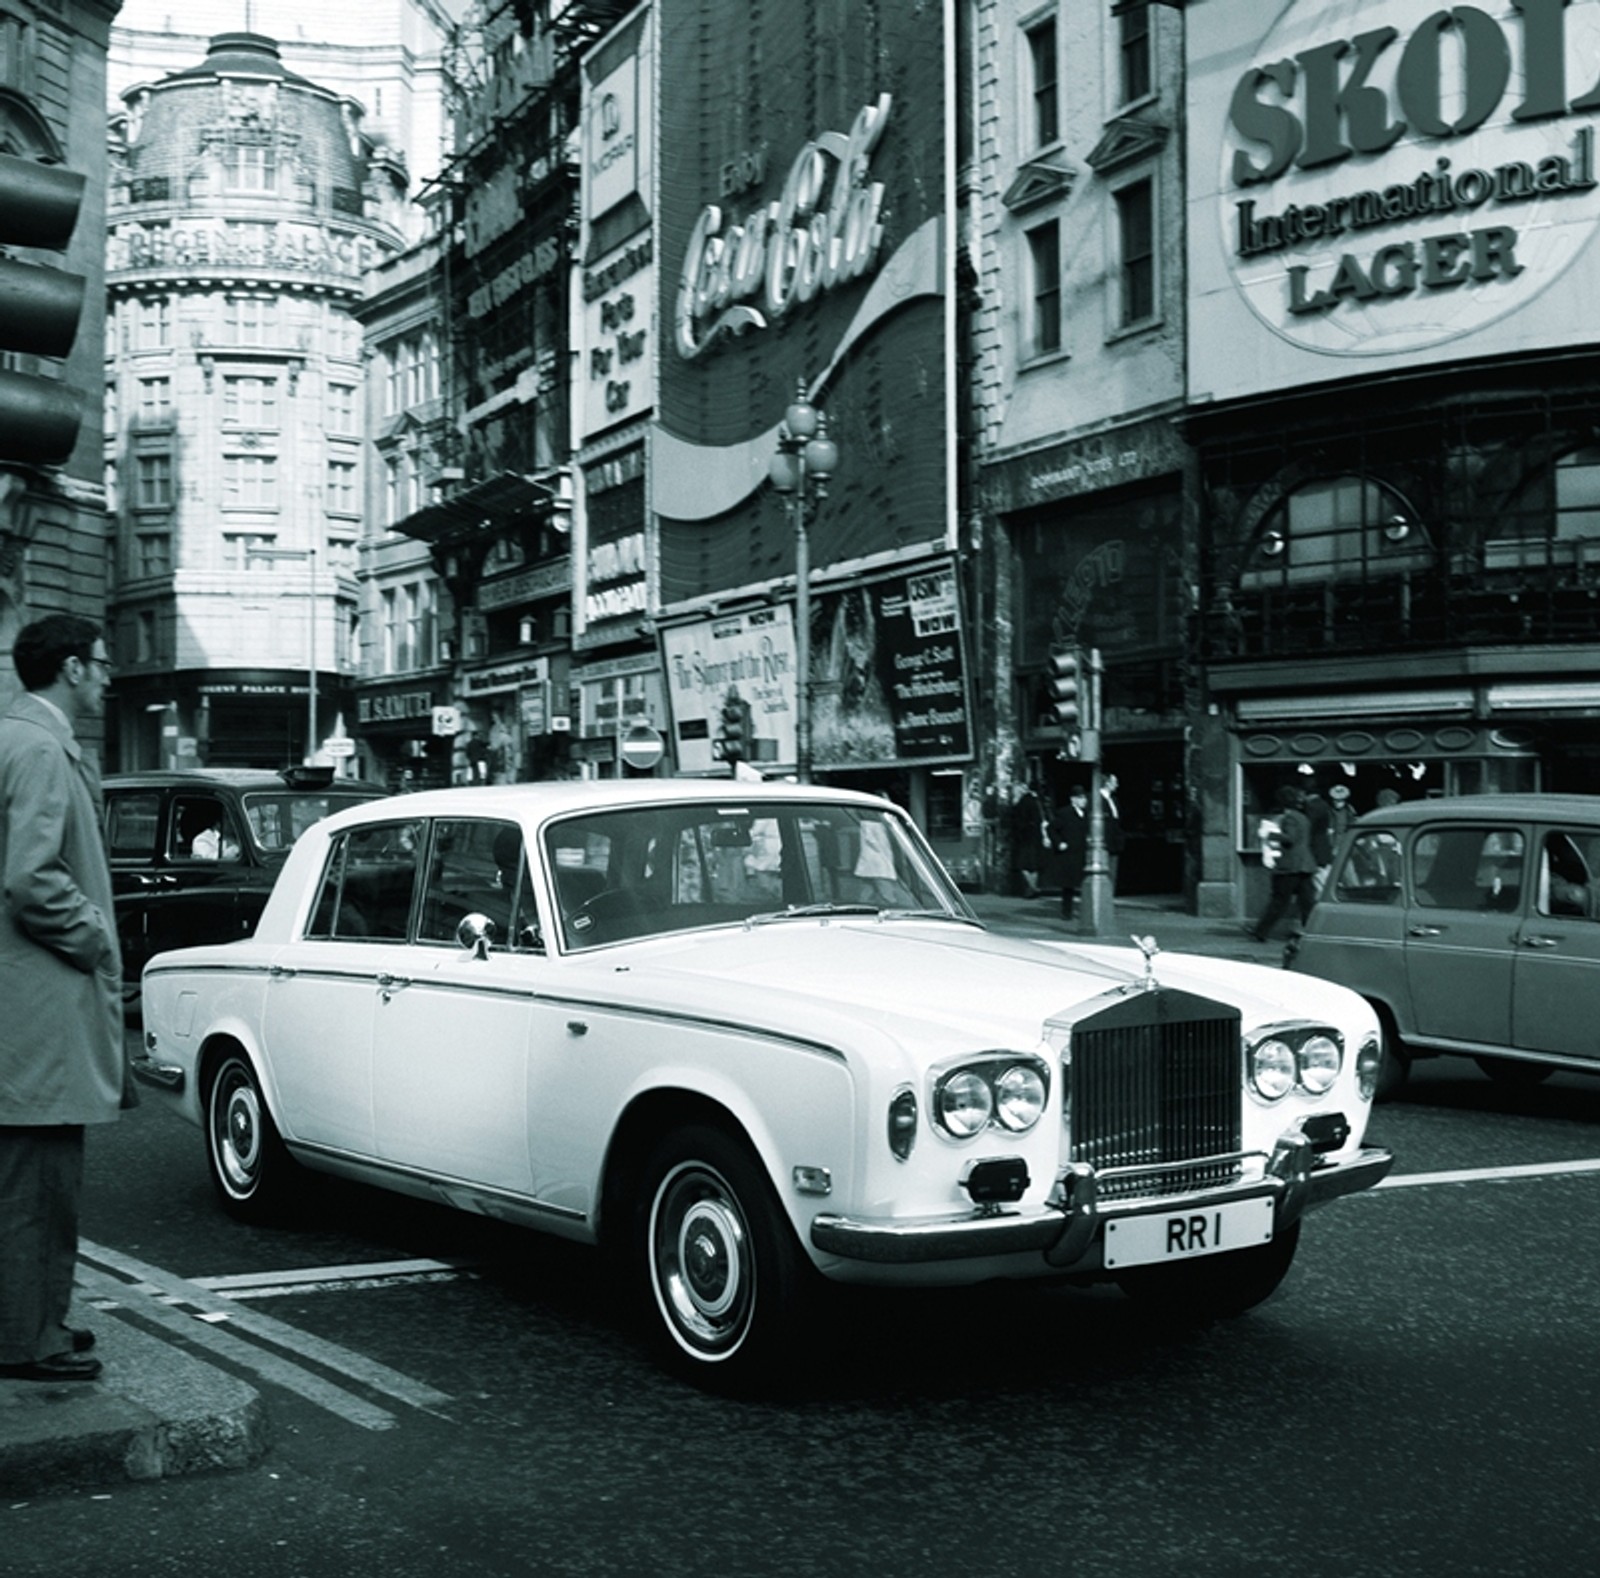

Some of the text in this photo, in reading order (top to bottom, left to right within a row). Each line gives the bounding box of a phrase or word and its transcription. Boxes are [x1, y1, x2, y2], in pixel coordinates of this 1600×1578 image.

[1236, 125, 1596, 258] International
[1286, 225, 1525, 315] LAGER
[919, 613, 956, 634] NOW
[242, 685, 286, 694] PALACE
[1167, 1215, 1207, 1253] RR
